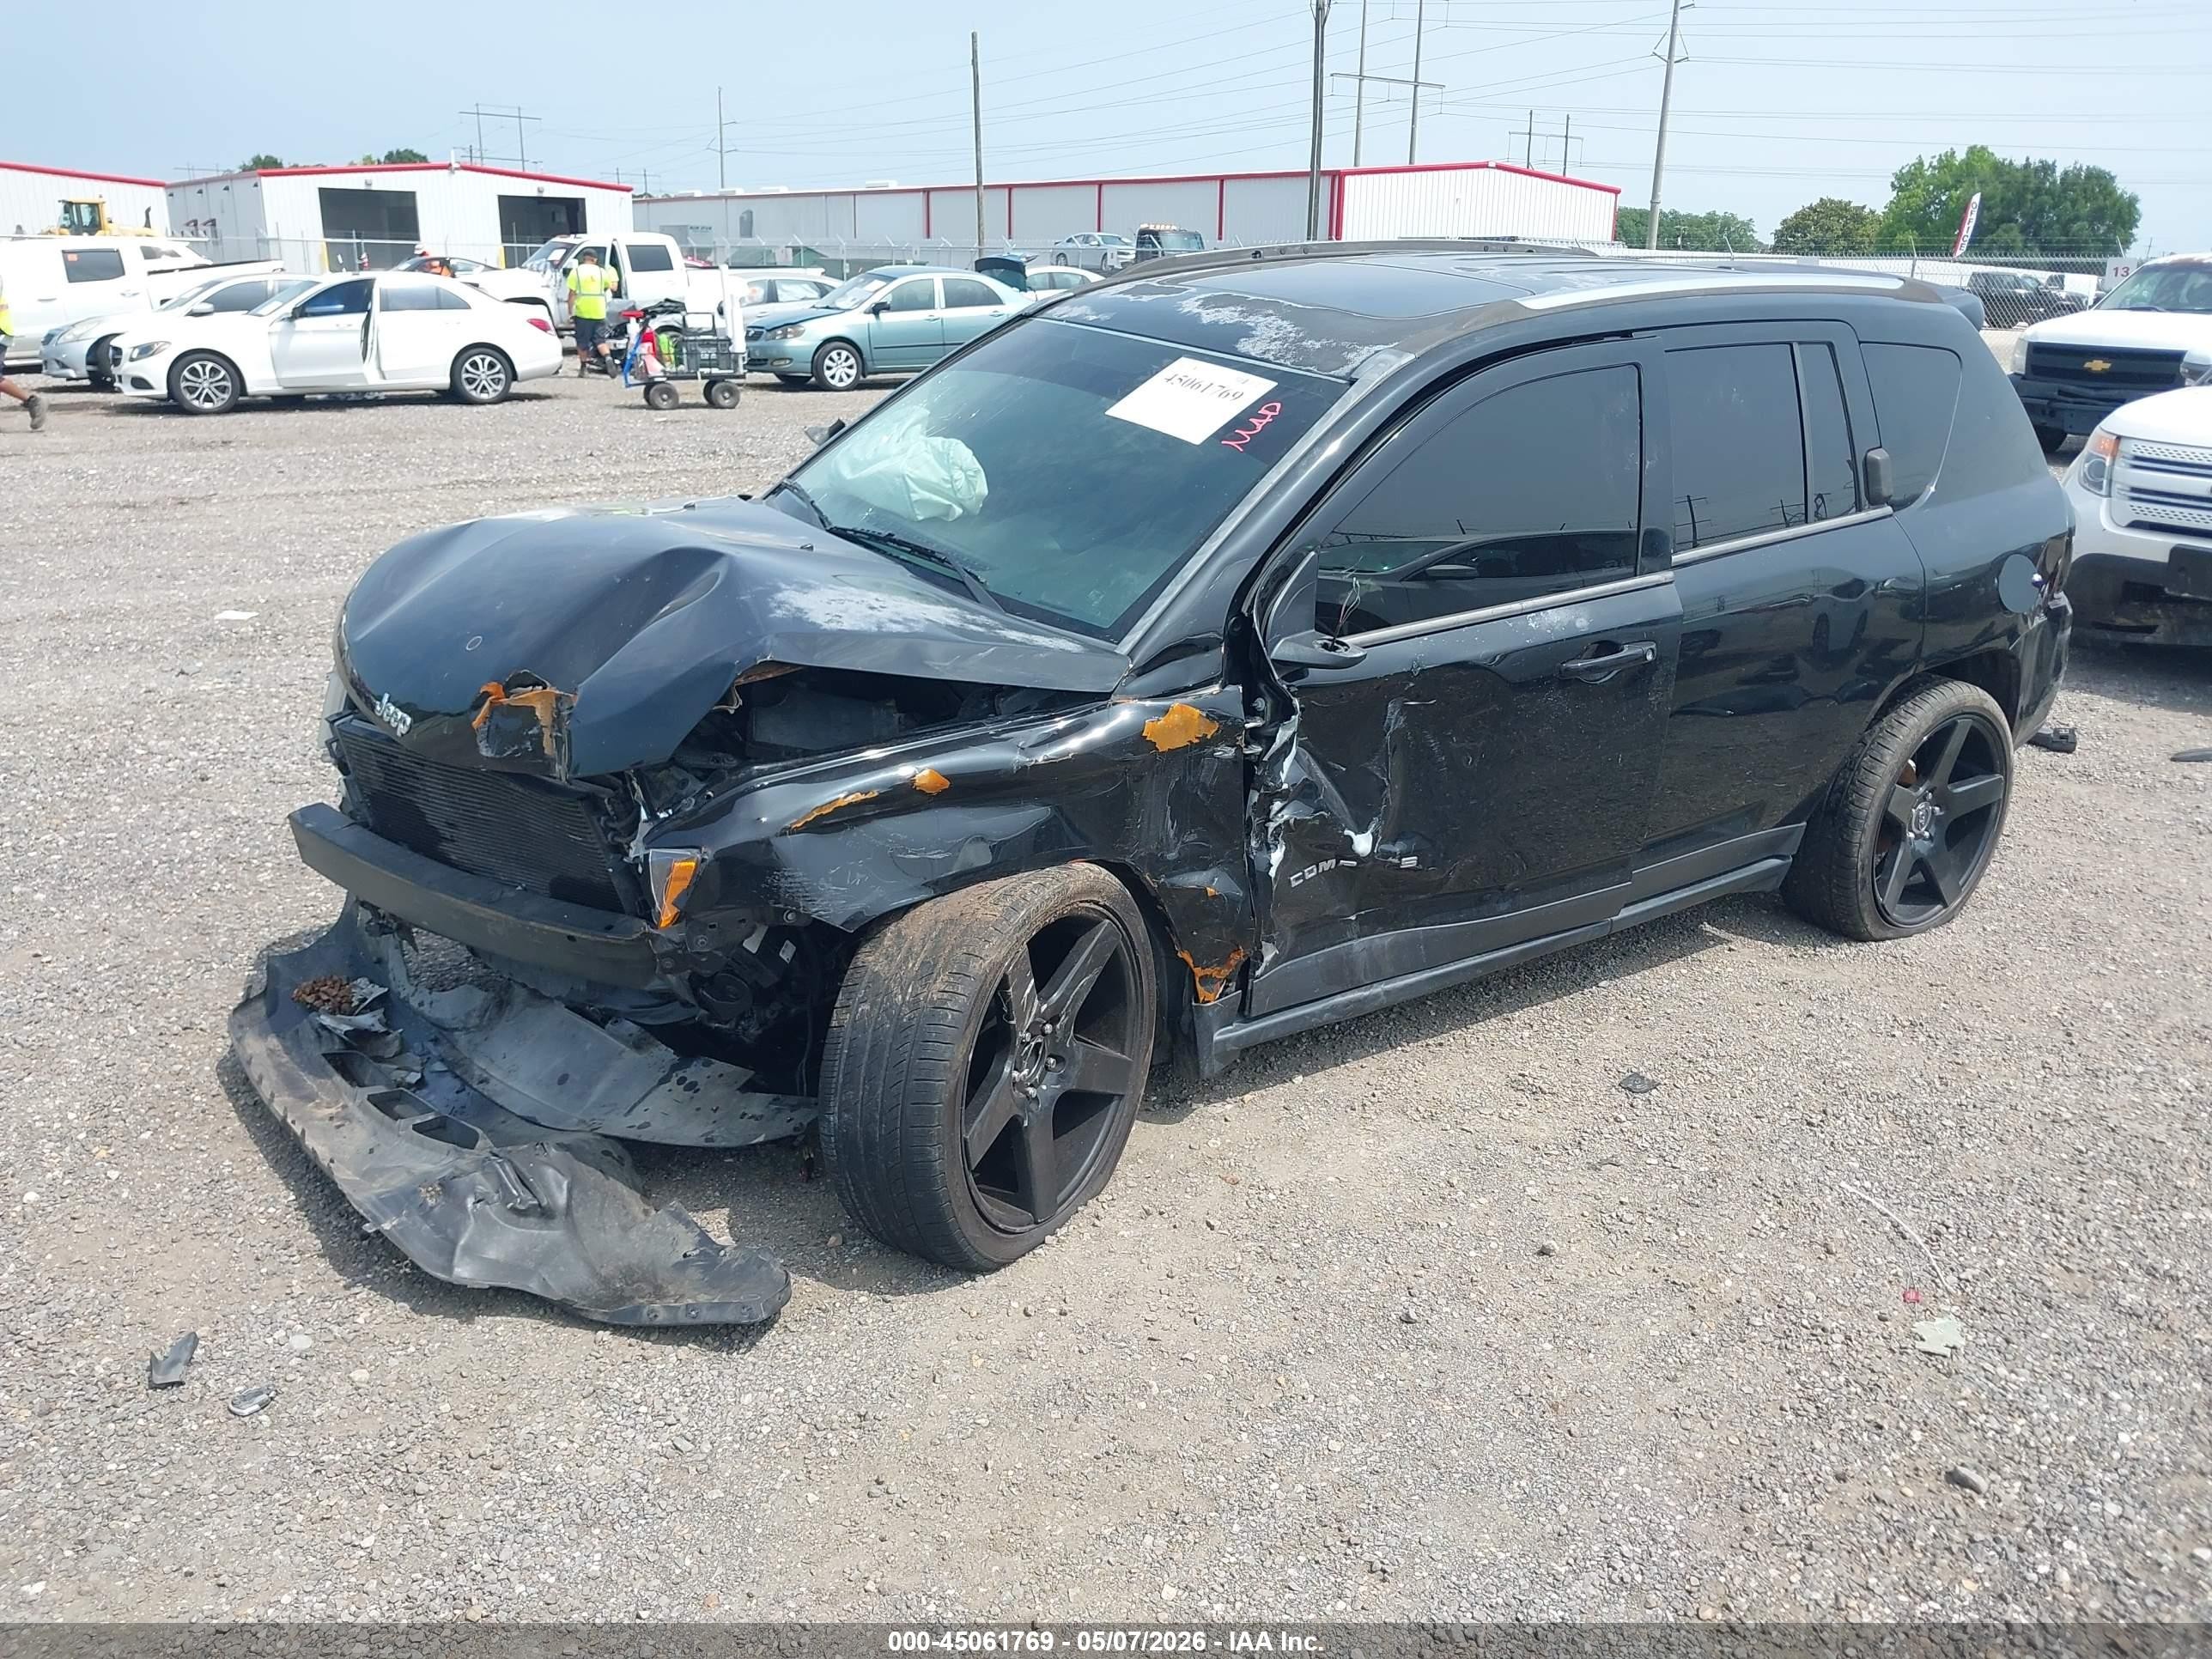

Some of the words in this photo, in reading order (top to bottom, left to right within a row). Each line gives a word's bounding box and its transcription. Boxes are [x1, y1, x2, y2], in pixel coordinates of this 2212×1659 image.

[1959, 202, 1978, 252] OFFICE
[2113, 266, 2130, 277] 13
[1164, 374, 1244, 402] 45061769
[374, 692, 411, 738] Jeep
